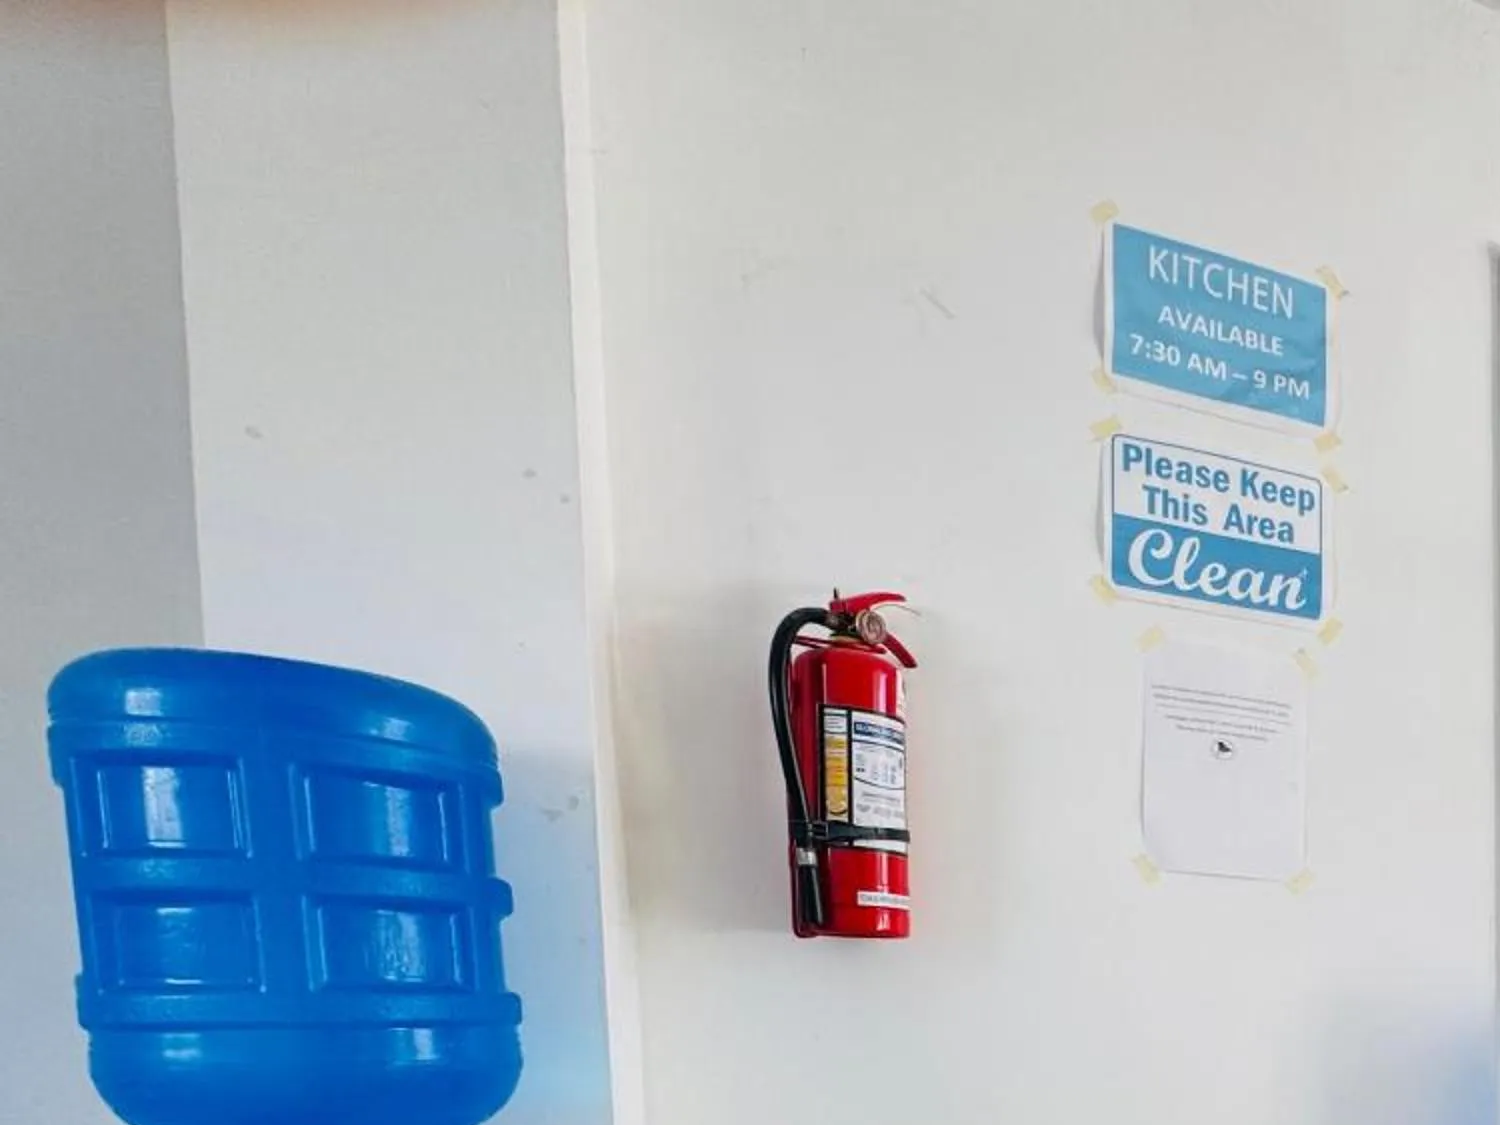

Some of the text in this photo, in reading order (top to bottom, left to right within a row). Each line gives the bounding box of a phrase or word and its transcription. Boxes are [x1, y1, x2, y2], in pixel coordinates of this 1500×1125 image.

[1149, 246, 1294, 320] KITCHEN
[1157, 305, 1284, 357] AVAILABLE
[1129, 334, 1181, 366] 7:30
[1187, 352, 1227, 380] AM
[1252, 369, 1267, 388] 9
[1273, 374, 1310, 400] PM
[1121, 443, 1316, 517] Please Keep
[1142, 483, 1295, 544] This Area
[1128, 528, 1308, 611] Clean
